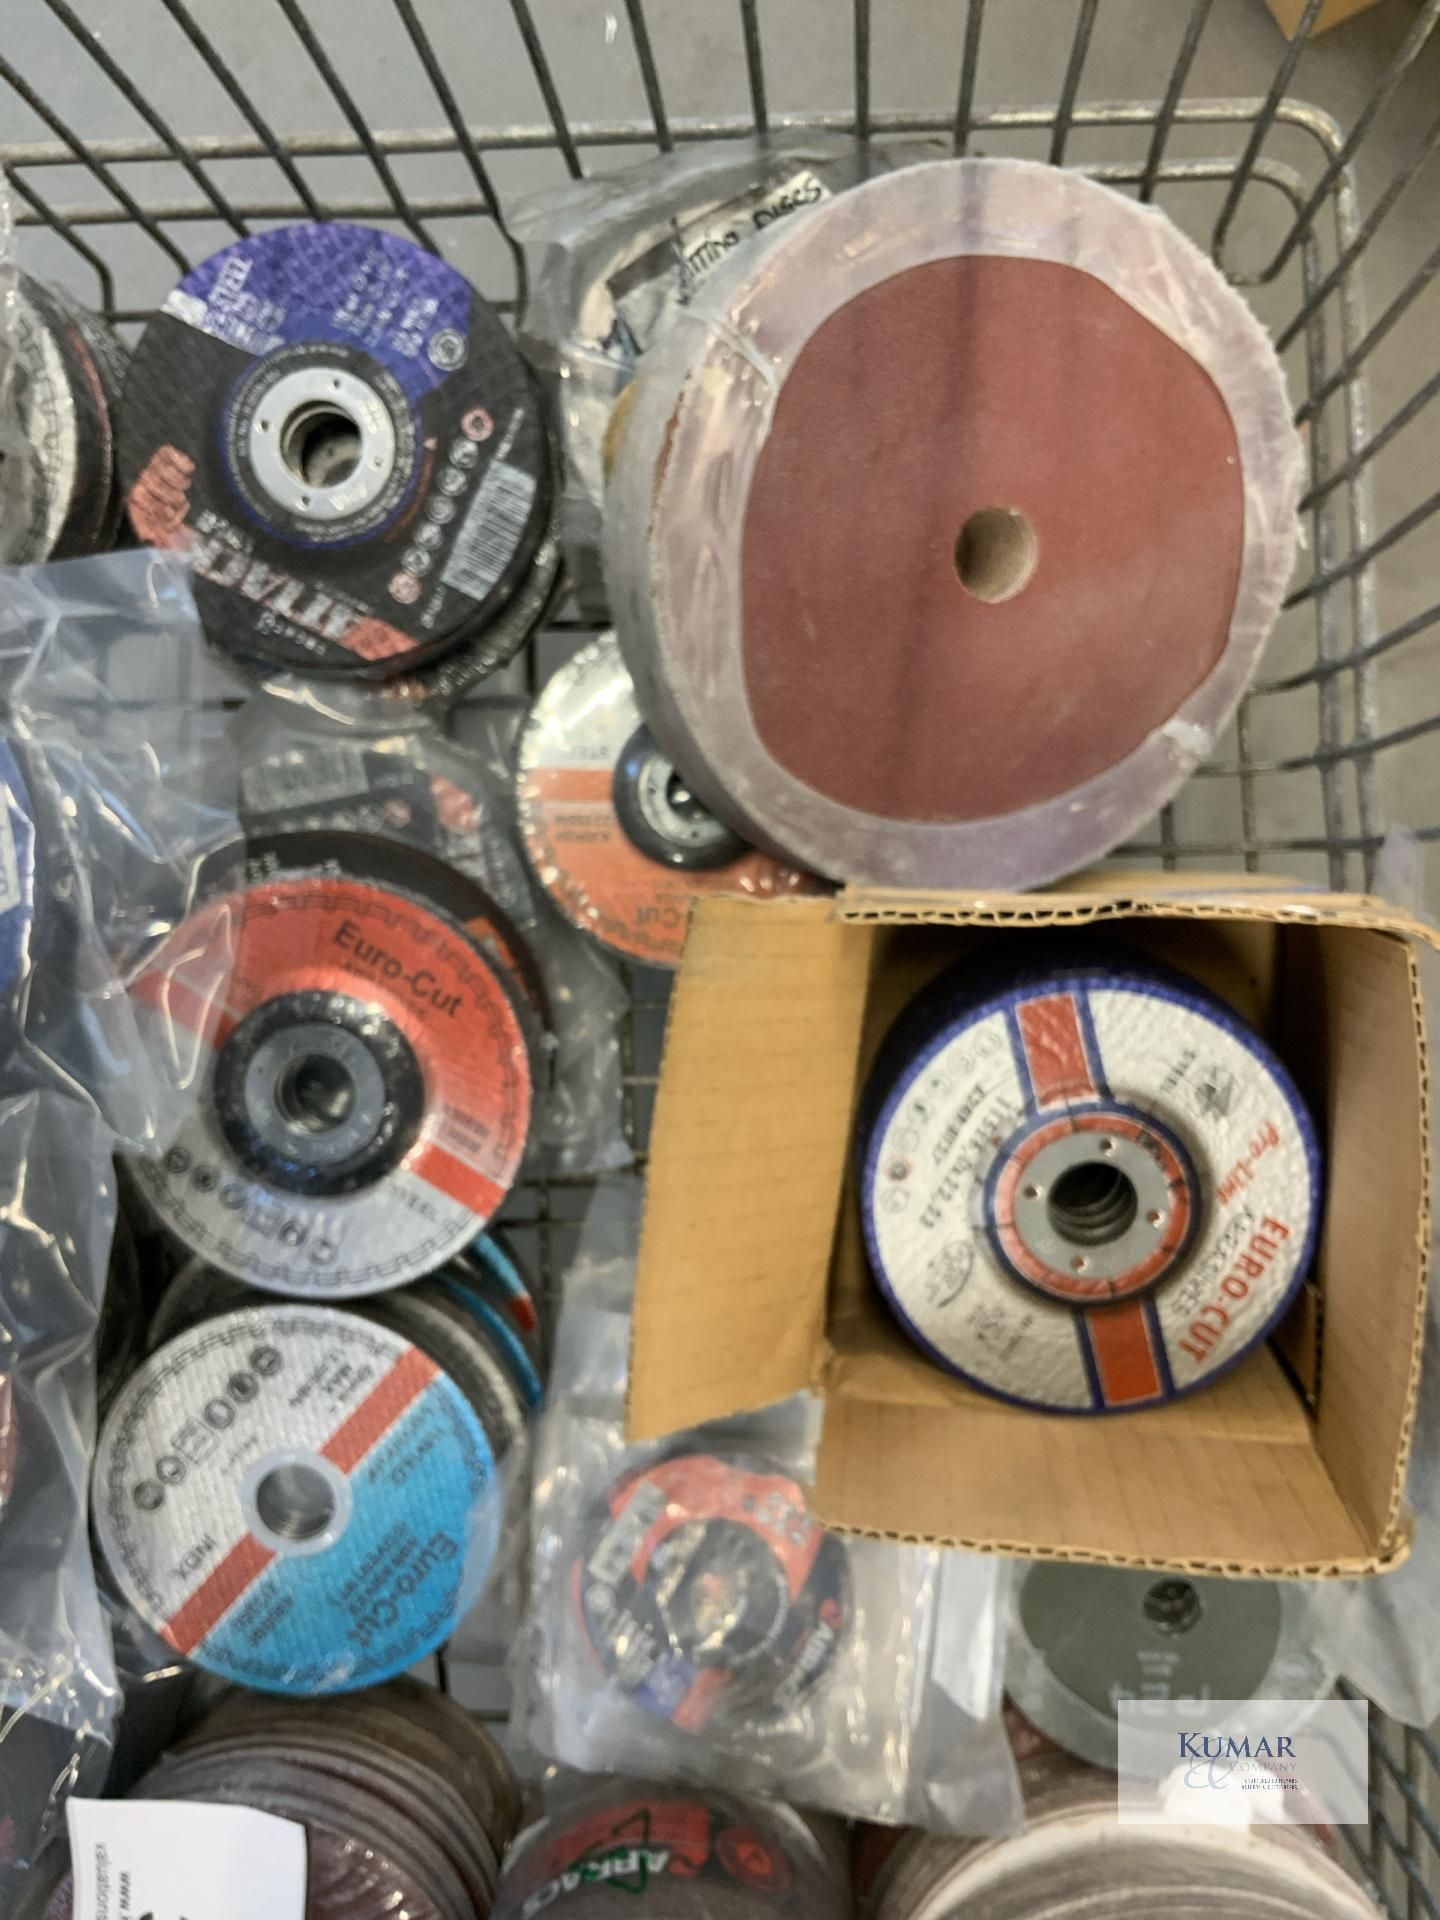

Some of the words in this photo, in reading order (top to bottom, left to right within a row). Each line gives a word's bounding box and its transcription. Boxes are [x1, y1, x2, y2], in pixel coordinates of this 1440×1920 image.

[332, 920, 466, 1019] Euro-Cut
[1216, 1122, 1280, 1207] Pro-Line
[1178, 1216, 1289, 1362] EURO-CUT
[175, 1533, 215, 1581] INOX
[347, 1529, 458, 1650] Euro-Cut
